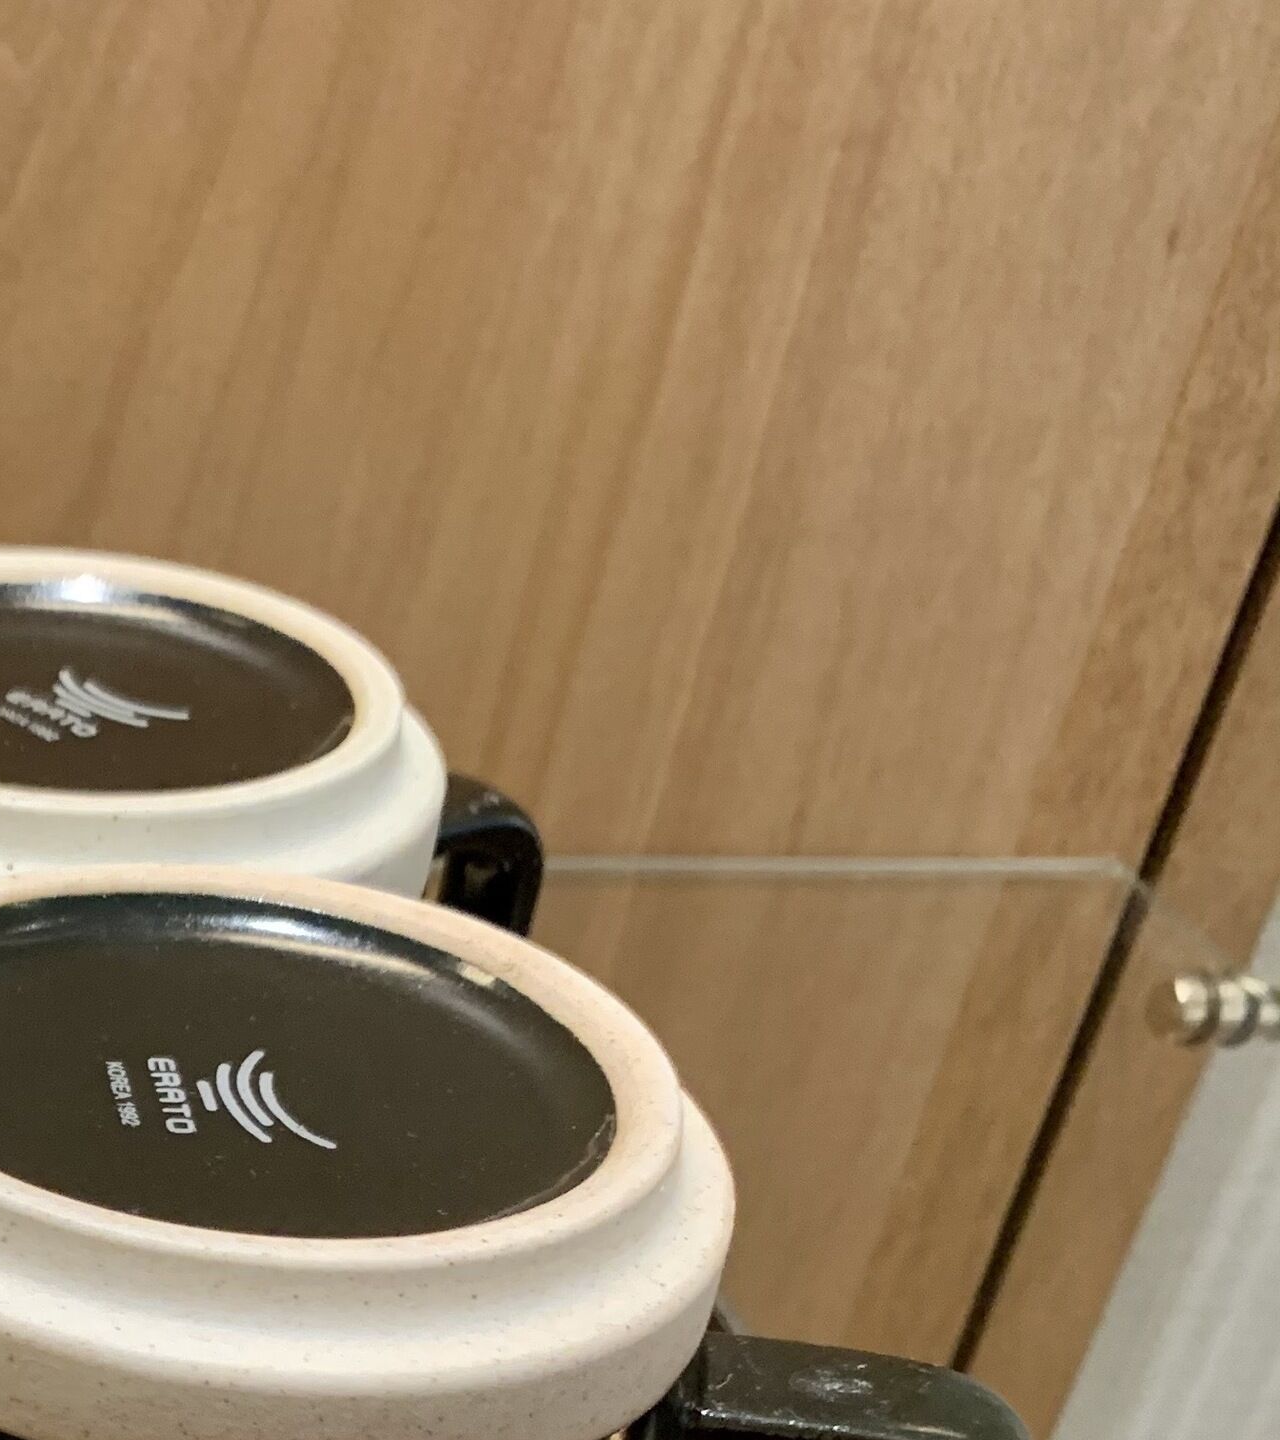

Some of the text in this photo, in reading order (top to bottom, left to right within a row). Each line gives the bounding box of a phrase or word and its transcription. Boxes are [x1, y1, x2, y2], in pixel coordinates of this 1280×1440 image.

[105, 1061, 141, 1128] KOREA 1992
[147, 1057, 197, 1134] ERATO
